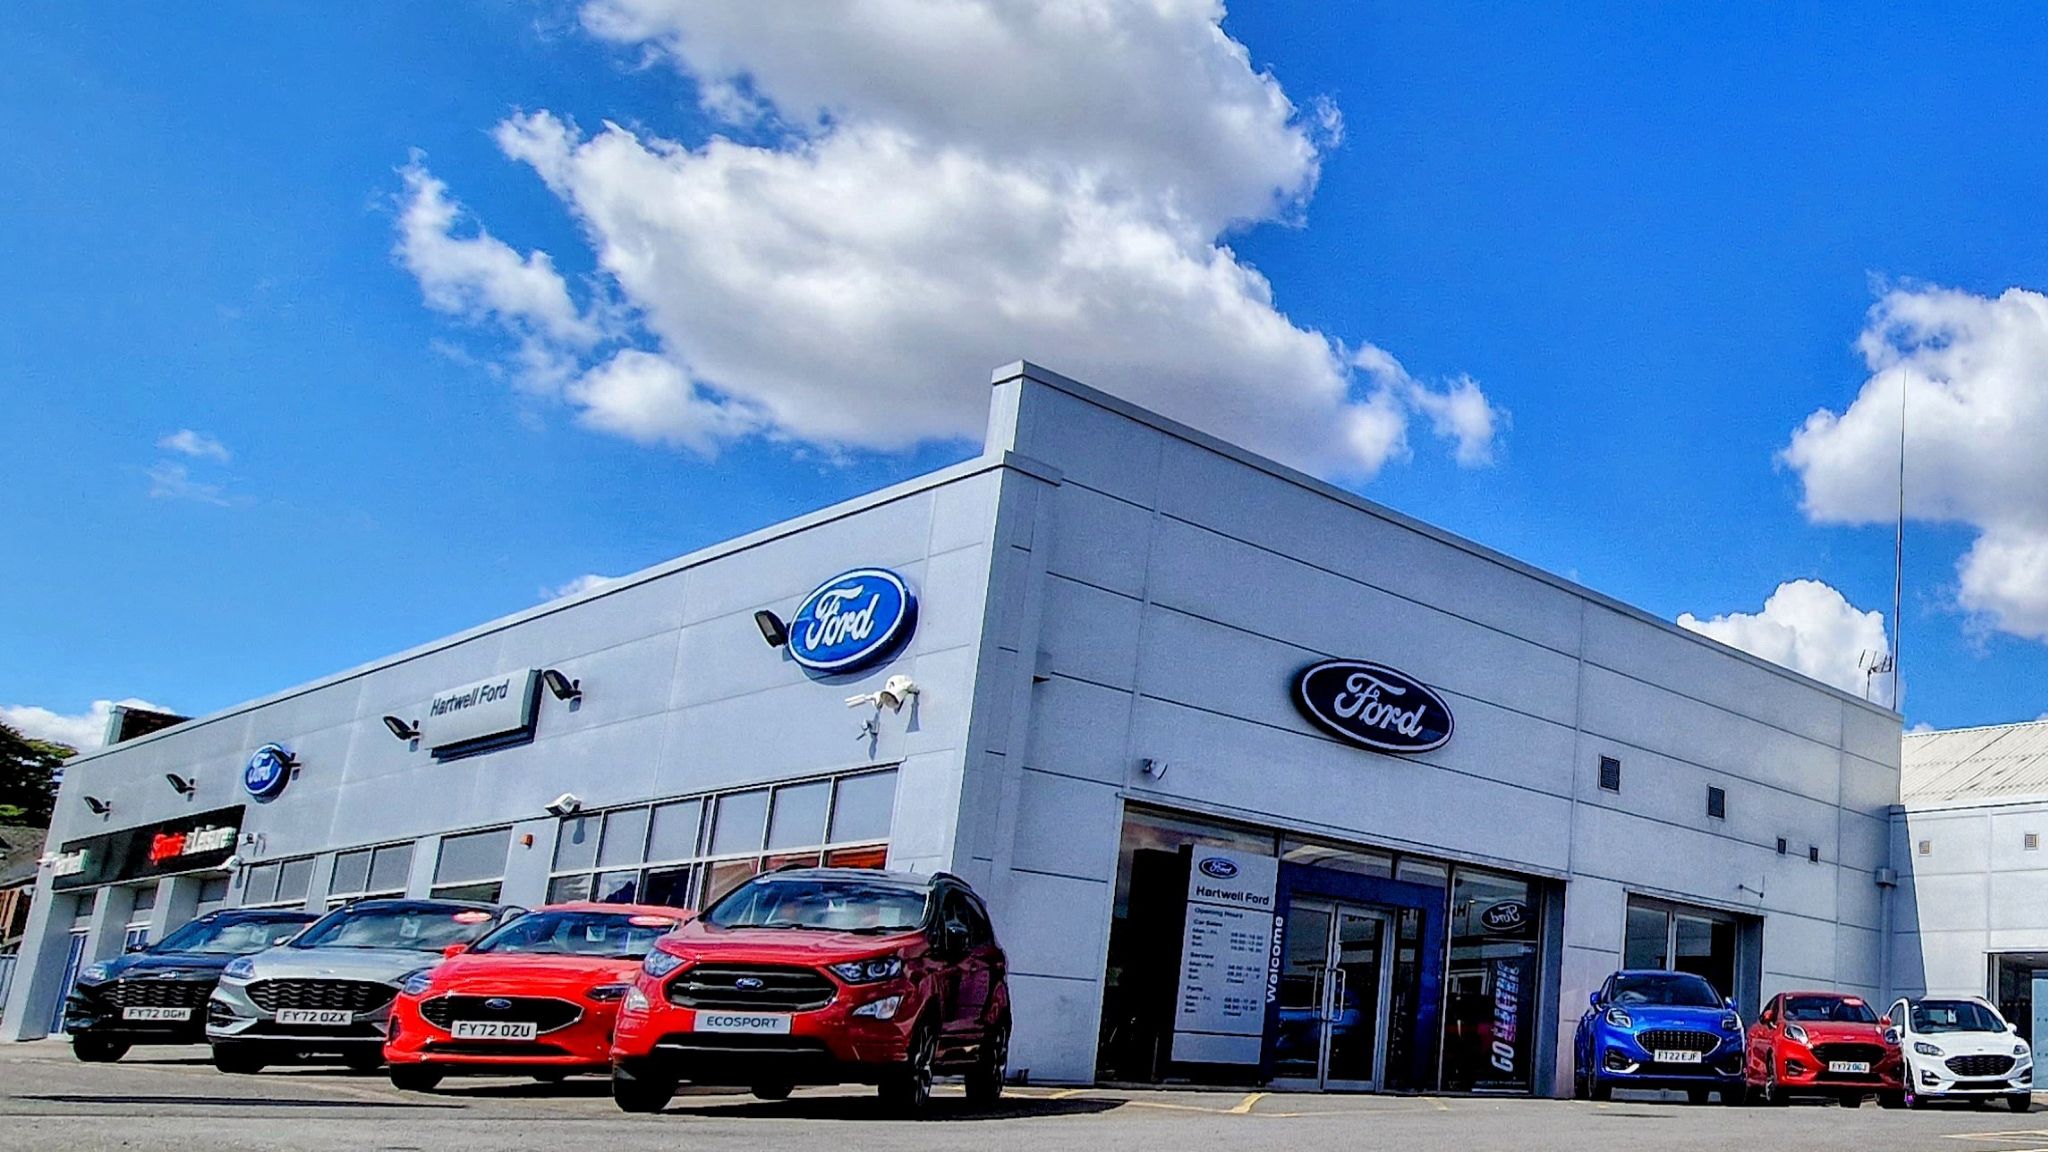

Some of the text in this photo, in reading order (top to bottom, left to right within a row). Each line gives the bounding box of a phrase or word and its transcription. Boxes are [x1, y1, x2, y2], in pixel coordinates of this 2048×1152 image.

[805, 585, 880, 650] Ford
[430, 678, 510, 717] Hartwell Ford
[1333, 672, 1427, 738] Ford
[1196, 886, 1270, 905] Hartwell Ford
[1266, 916, 1284, 1003] Welcome
[282, 1012, 347, 1023] FY72 OZX
[458, 1023, 531, 1037] FY72 OZU
[707, 1016, 779, 1028] ECOSPORT
[1491, 1041, 1514, 1072] GO
